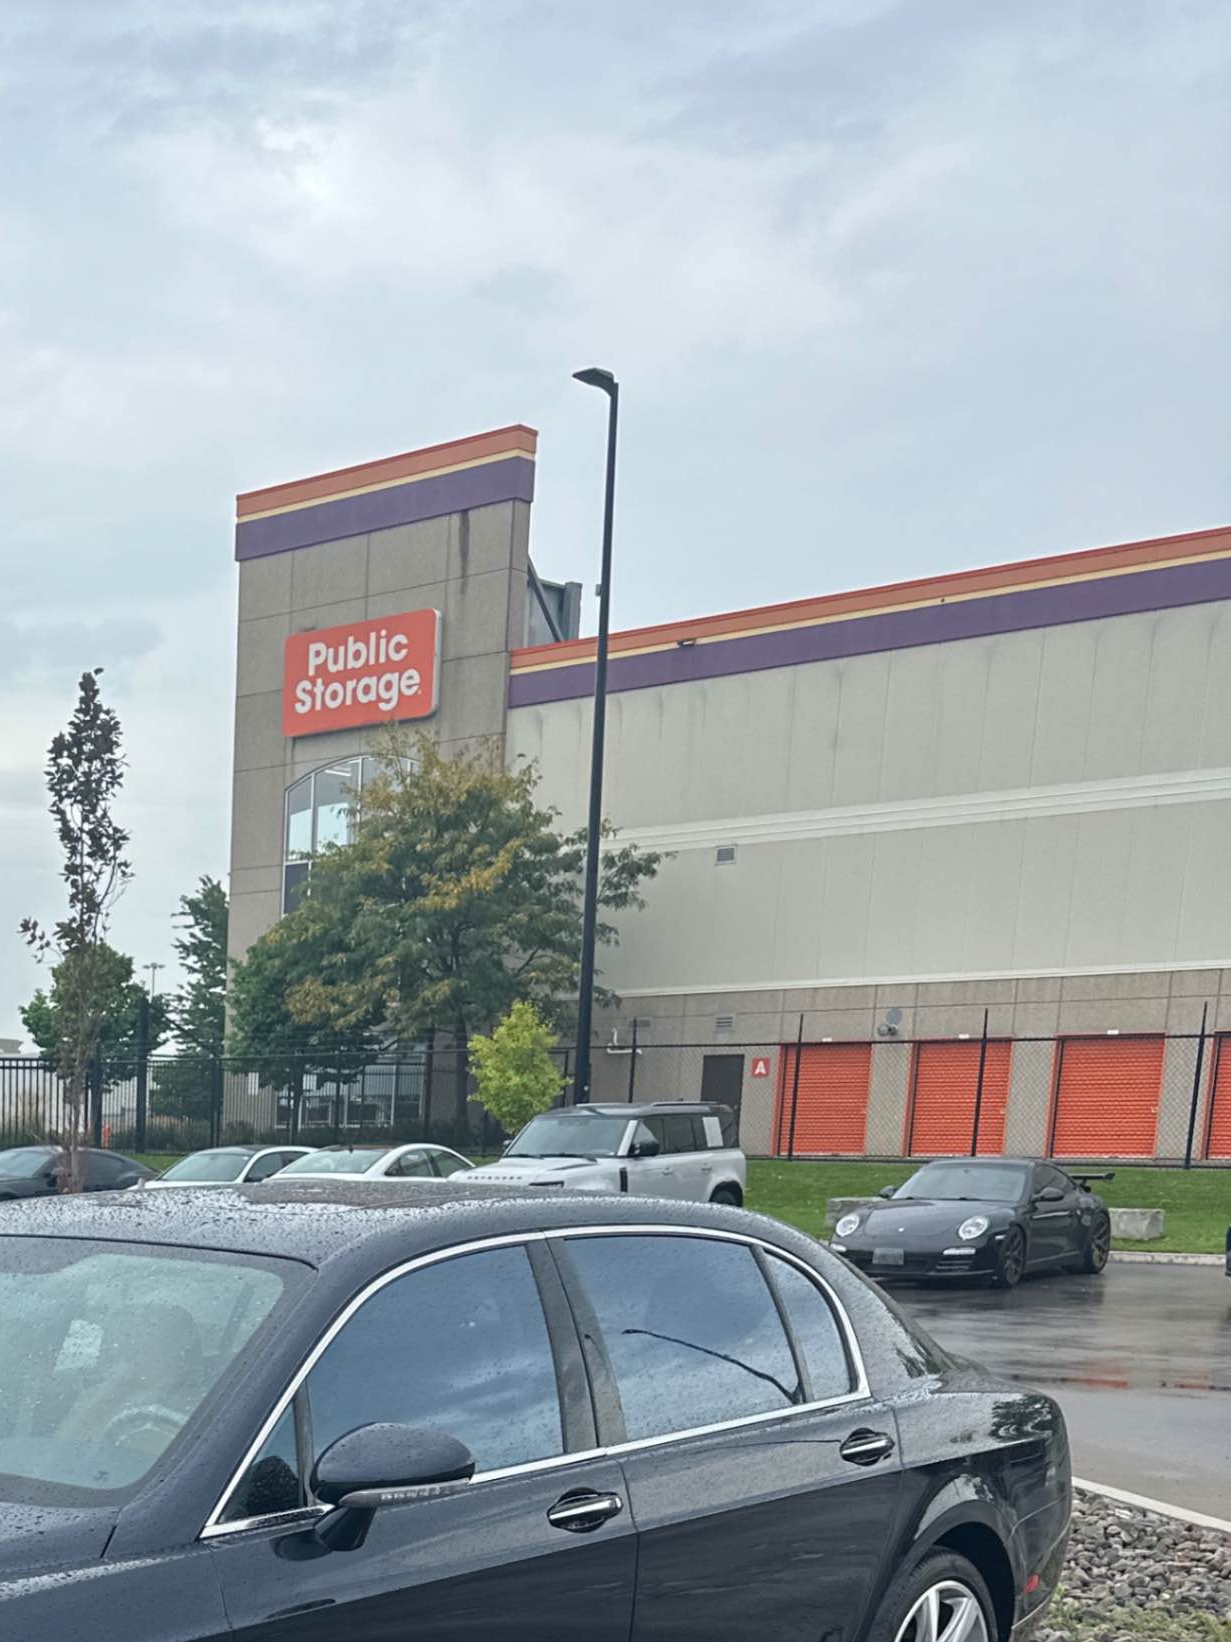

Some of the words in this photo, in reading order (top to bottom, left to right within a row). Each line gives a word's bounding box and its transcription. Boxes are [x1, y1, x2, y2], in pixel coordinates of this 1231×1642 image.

[308, 629, 408, 677] Public
[294, 668, 420, 714] Storage
[754, 1060, 766, 1075] A
